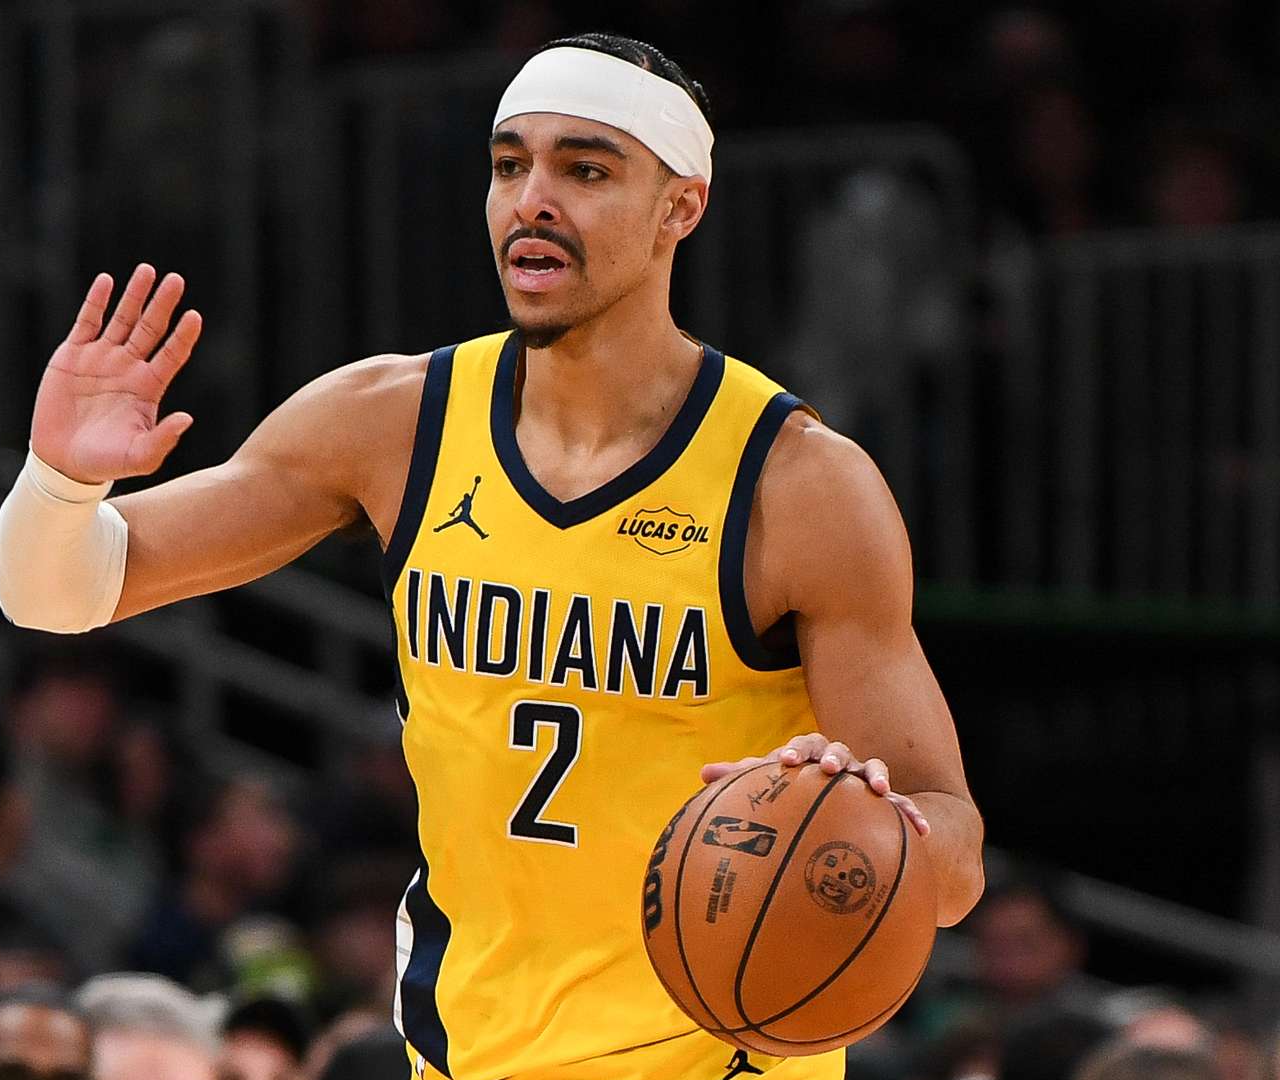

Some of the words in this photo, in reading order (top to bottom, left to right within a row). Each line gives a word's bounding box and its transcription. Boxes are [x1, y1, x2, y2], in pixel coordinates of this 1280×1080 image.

[617, 518, 679, 540] LUCAS
[681, 525, 709, 543] OIL
[407, 568, 710, 699] INDIANA
[507, 699, 583, 849] 2
